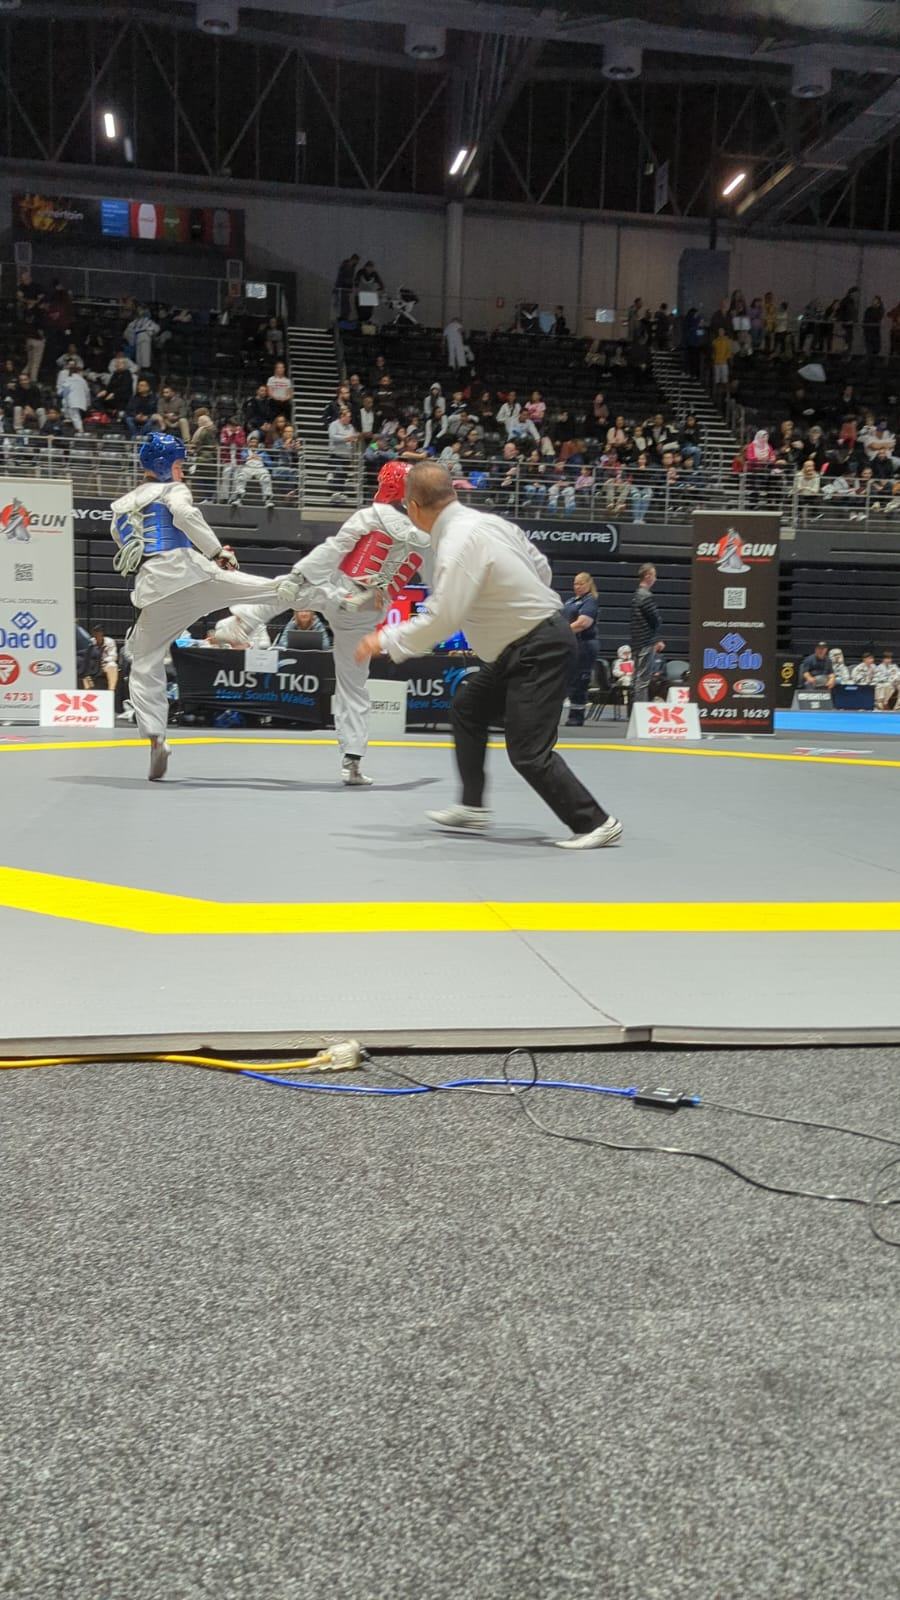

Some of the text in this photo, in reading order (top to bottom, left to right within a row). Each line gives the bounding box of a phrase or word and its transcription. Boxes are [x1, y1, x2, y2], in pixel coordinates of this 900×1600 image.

[213, 669, 320, 693] AUS TKD
[407, 679, 444, 696] AUS
[244, 690, 277, 702] South
[281, 691, 316, 706] Wales
[710, 708, 738, 718] 4731
[742, 709, 771, 718] 1629
